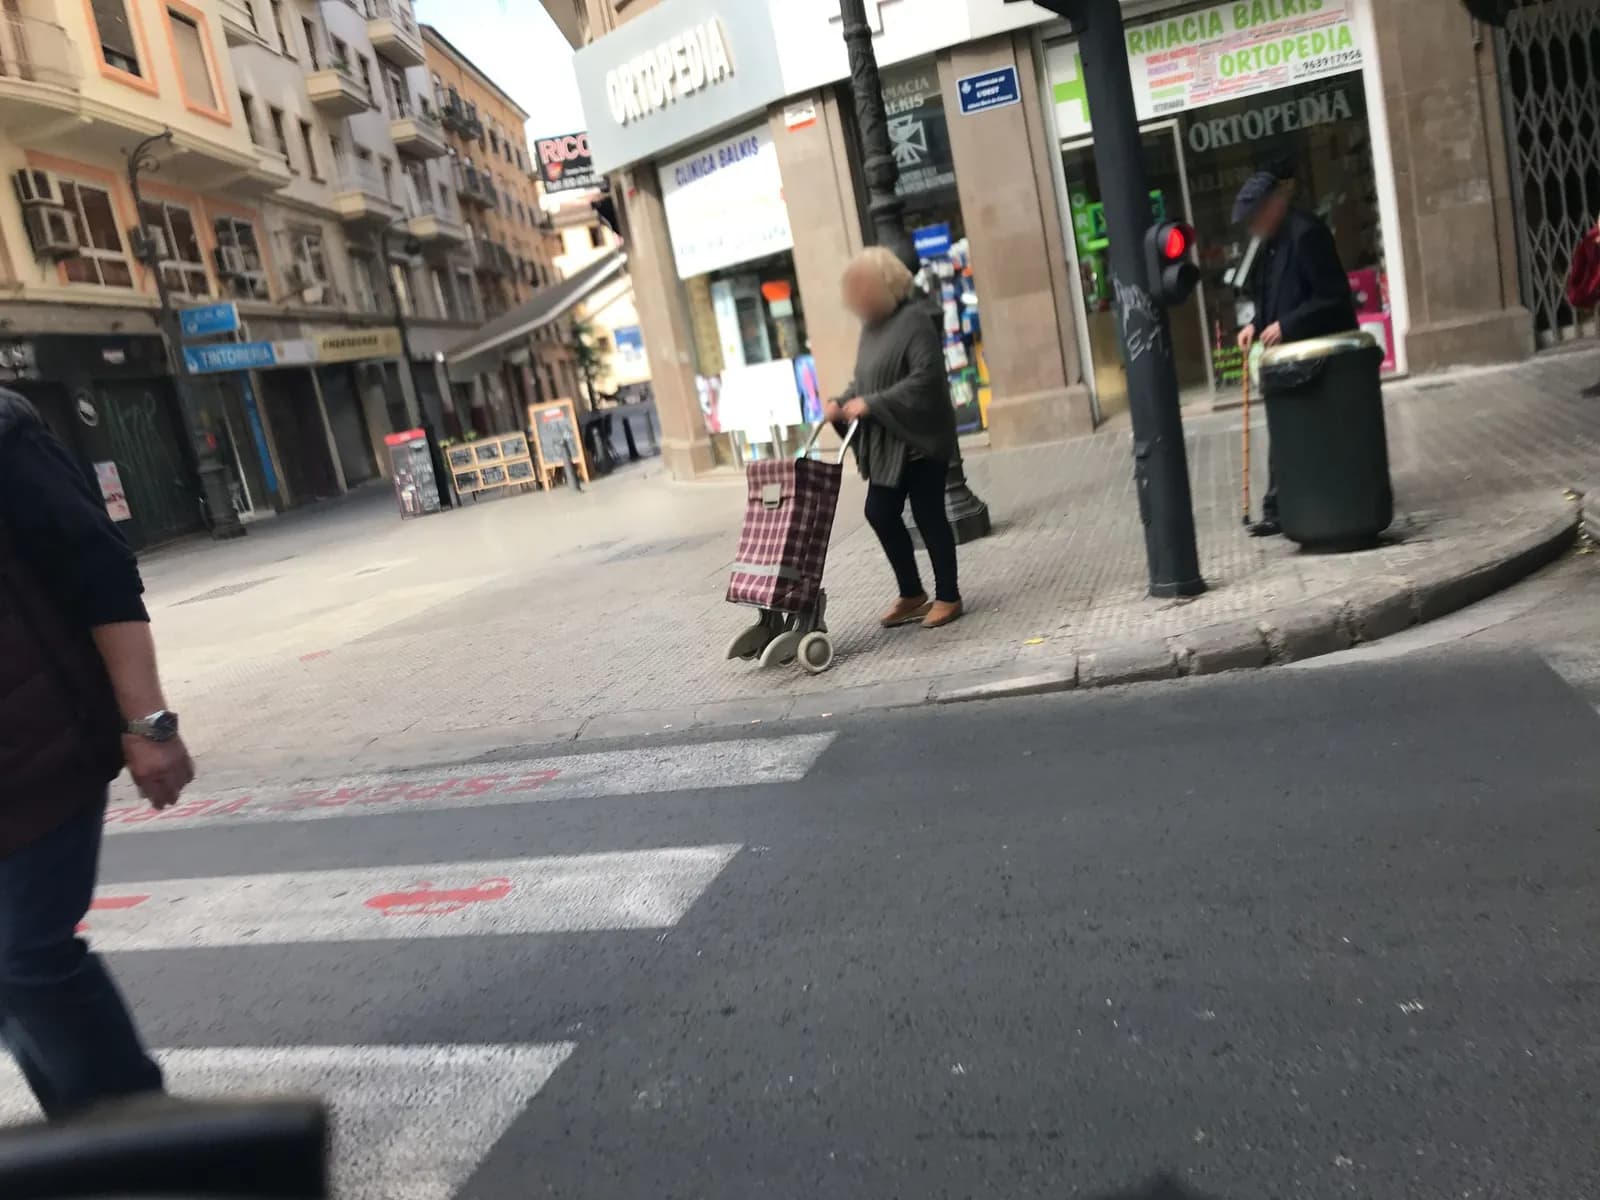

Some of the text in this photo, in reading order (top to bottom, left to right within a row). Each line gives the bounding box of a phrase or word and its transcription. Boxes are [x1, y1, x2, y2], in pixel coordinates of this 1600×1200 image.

[1128, 11, 1224, 56] RMACIA
[1219, 25, 1353, 77] ORTOPEDIA
[606, 16, 734, 126] ORTOPEDIA
[881, 77, 929, 100] MACIA
[1188, 88, 1353, 152] ORTOPEDIA
[719, 135, 759, 169] BALKIS
[103, 796, 252, 825] VERD
